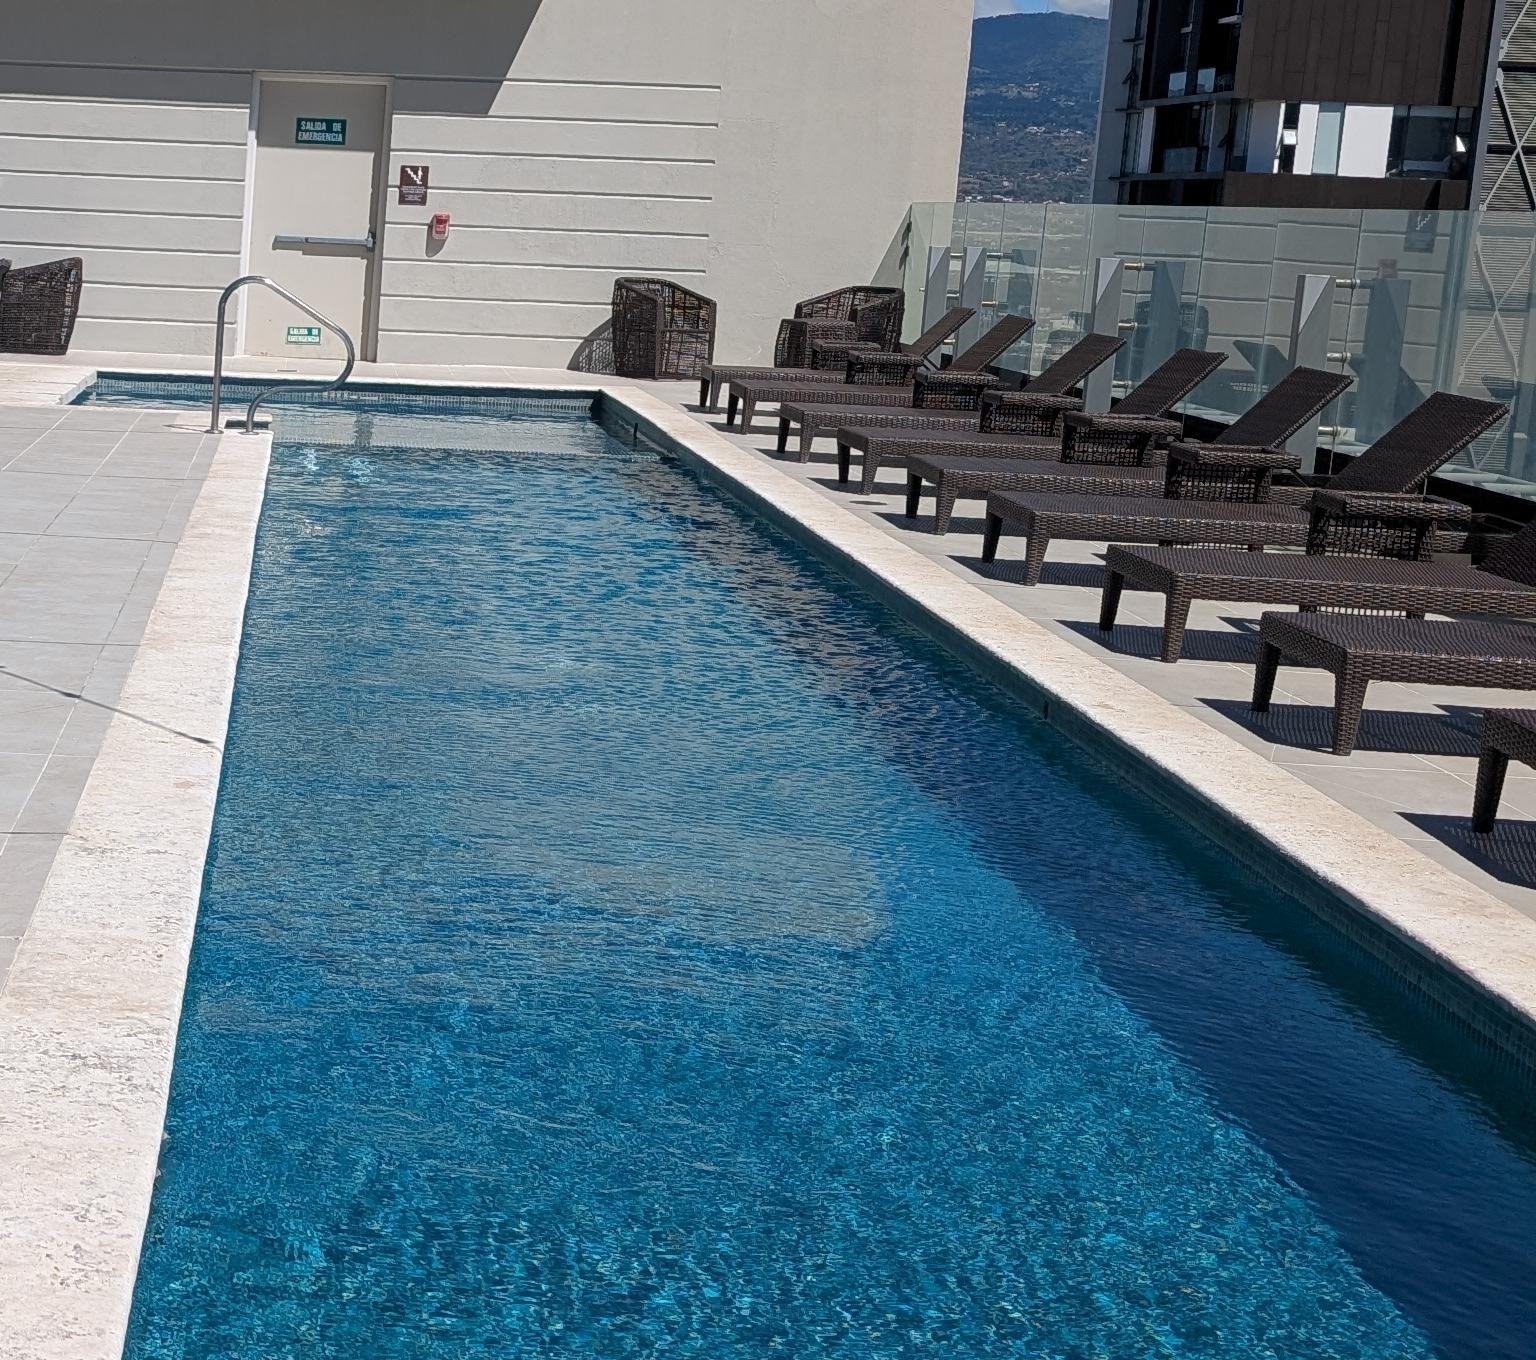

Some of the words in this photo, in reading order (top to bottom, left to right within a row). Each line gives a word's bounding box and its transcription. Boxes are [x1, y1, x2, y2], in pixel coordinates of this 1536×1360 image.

[300, 120, 326, 131] SALIDA
[332, 122, 342, 131] DE
[297, 131, 343, 142] EMERGENCIA
